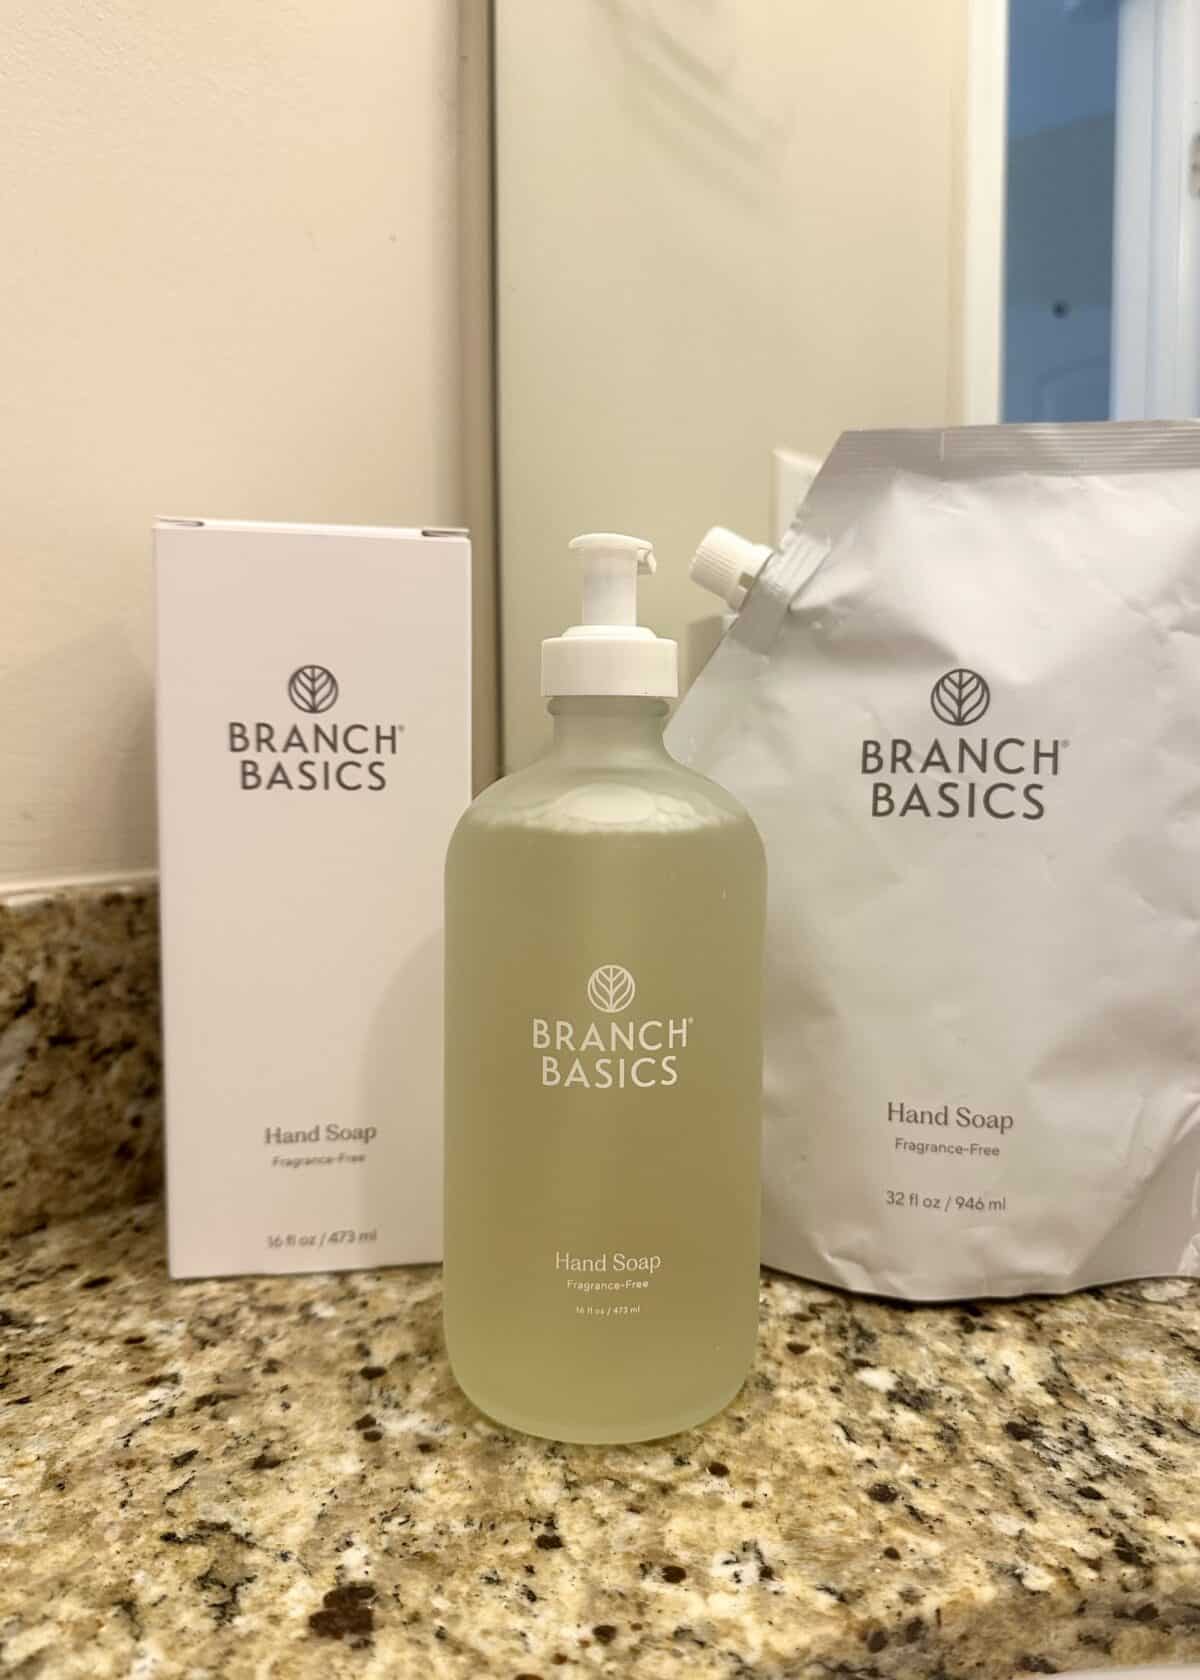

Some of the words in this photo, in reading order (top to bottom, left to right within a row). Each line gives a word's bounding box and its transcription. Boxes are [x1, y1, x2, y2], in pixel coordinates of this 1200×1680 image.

[228, 721, 397, 754] BRANCH
[861, 737, 1060, 775] BRANCH
[240, 759, 387, 791] BASICS
[871, 781, 1045, 819] BASICS
[532, 1018, 688, 1051] BRANCH
[541, 1055, 678, 1088] BASICS
[264, 1125, 320, 1144] Hand
[325, 1123, 377, 1144] Soap
[887, 1101, 949, 1126] Hand
[955, 1106, 1014, 1135] Soap
[895, 1137, 1001, 1156] Fragrance-Free
[886, 1190, 905, 1206] 32
[908, 1193, 919, 1207] fl
[922, 1197, 941, 1209] oz
[955, 1196, 985, 1210] 946
[988, 1196, 1006, 1211] ml
[327, 1230, 356, 1244] 473
[555, 1251, 607, 1272] Hand
[613, 1253, 662, 1274] Soap
[567, 1280, 649, 1292] Fragrance-Free
